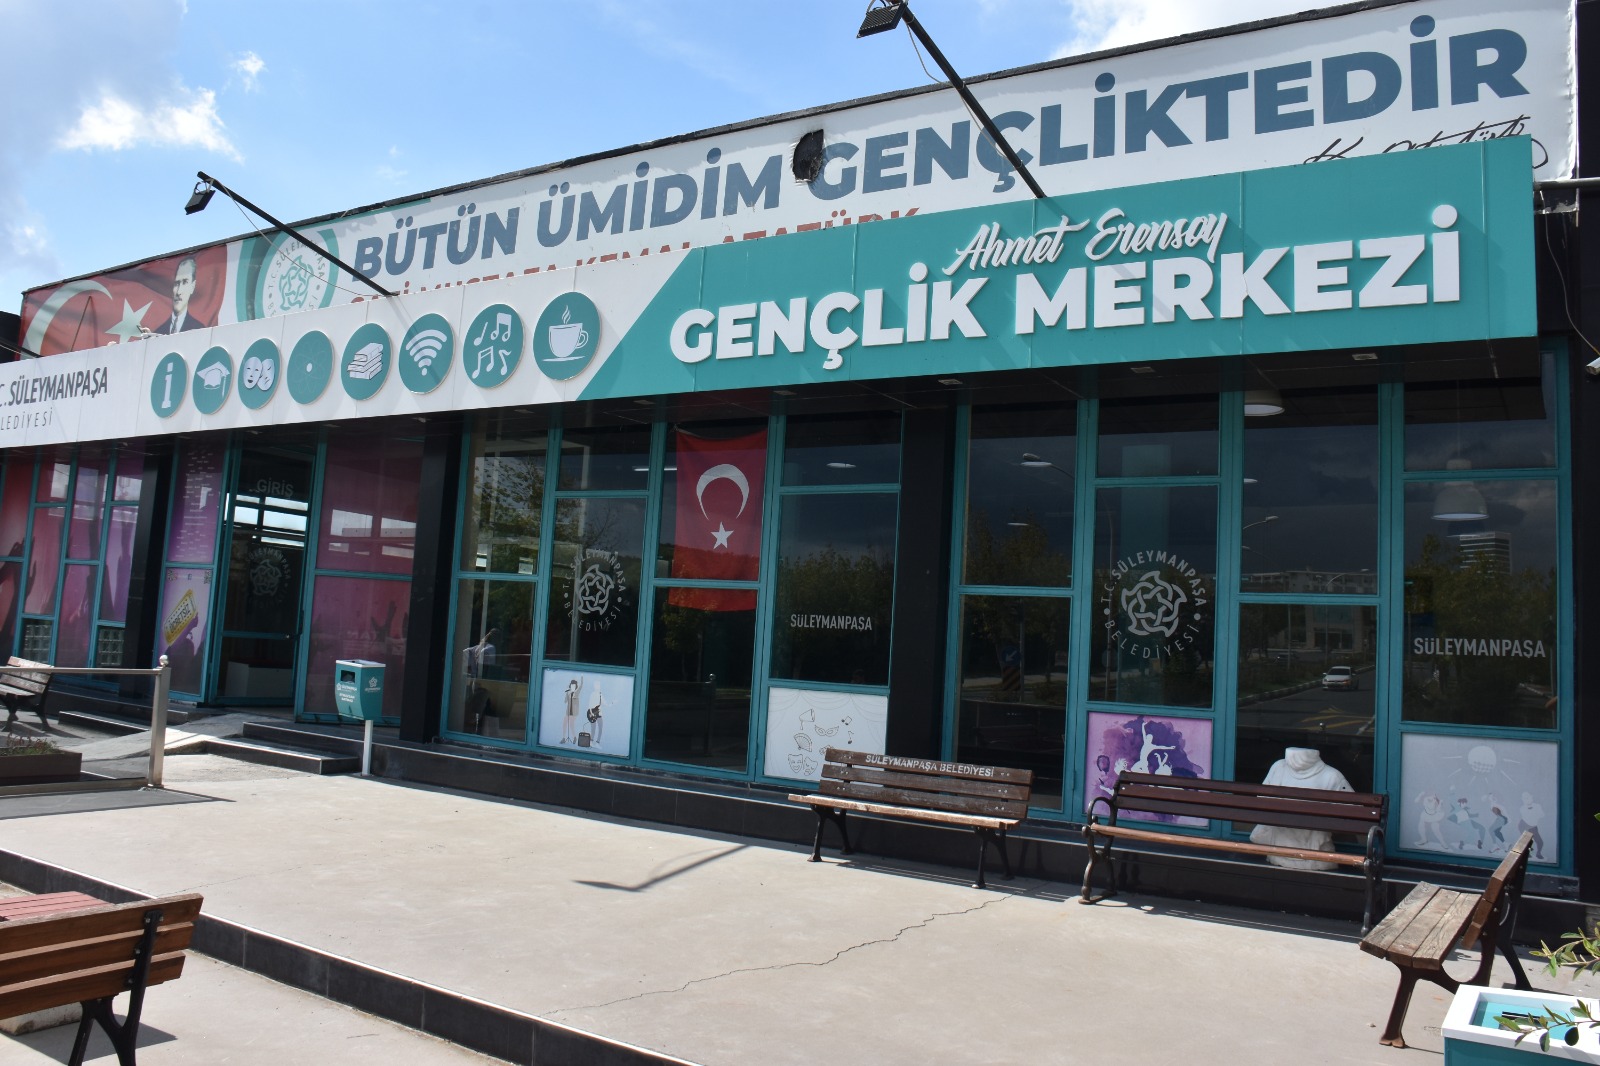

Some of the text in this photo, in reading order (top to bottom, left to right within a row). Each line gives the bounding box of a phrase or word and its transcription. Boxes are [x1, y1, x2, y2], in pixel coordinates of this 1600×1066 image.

[352, 203, 520, 282] BÜTÜN
[536, 147, 783, 248] ÜMİDİM
[807, 15, 1530, 201] GENÇLİKTEDİR
[942, 215, 1090, 276] Ahmet
[1085, 207, 1228, 264] Erensoy
[670, 204, 1460, 370] GENÇLİK MERKEZİ
[257, 478, 294, 500] GİRİŞ
[790, 613, 873, 632] SÜLEYMANPAŞA
[1104, 620, 1199, 659] BELEDİYESİ
[1413, 637, 1547, 659] SÜLEYMANPAŞA
[865, 754, 995, 778] SÜLEYMANPAŞA BELEDİYESİ
